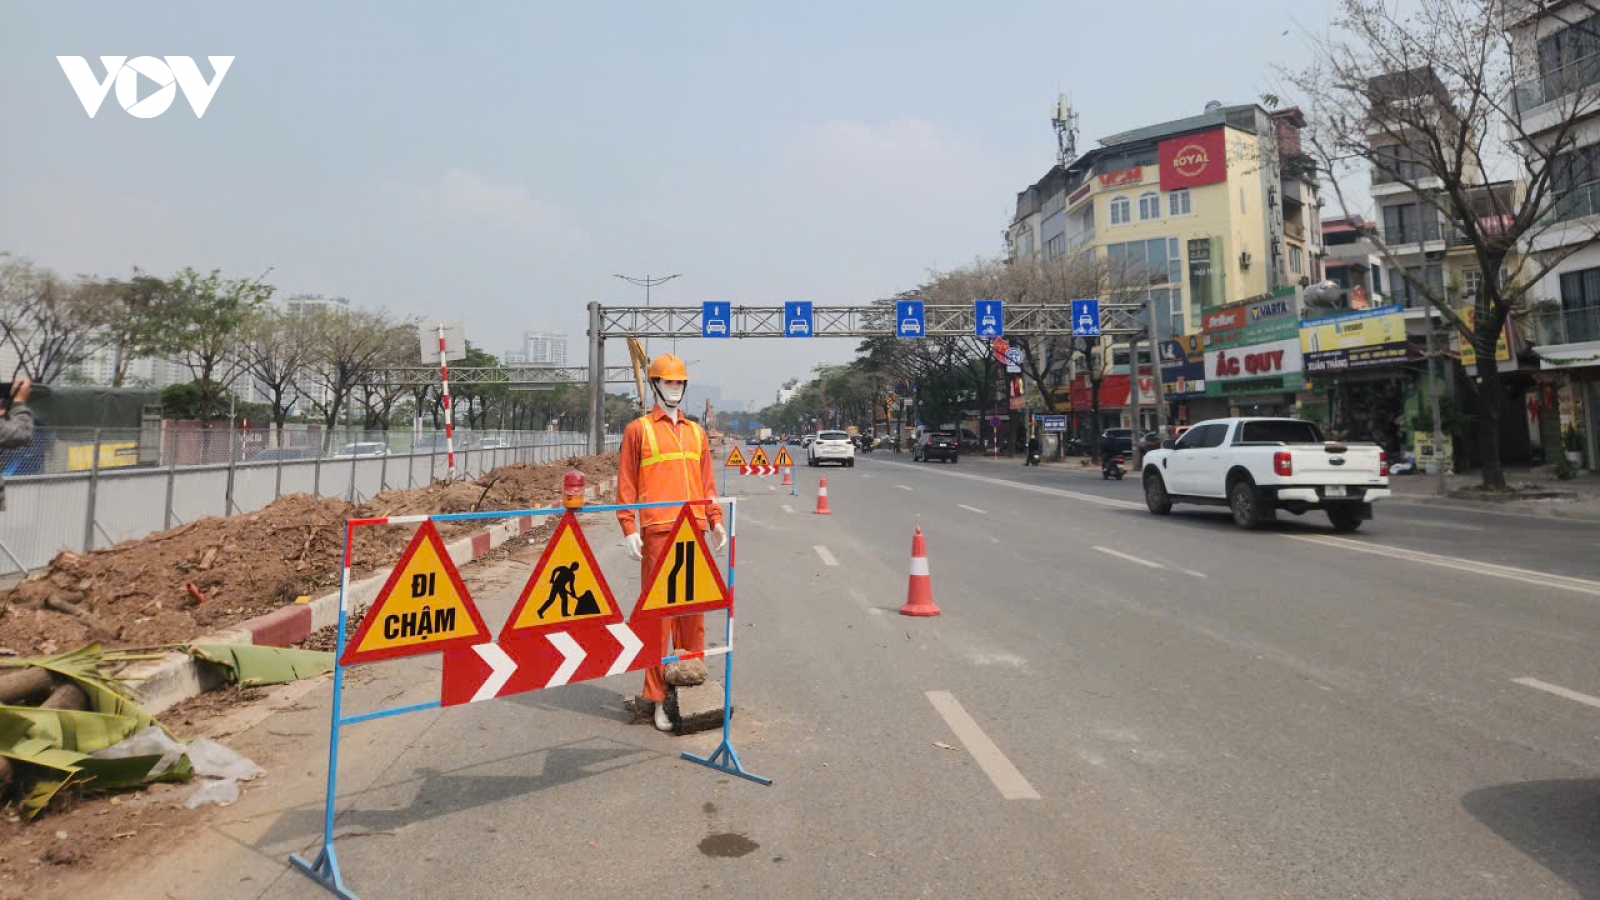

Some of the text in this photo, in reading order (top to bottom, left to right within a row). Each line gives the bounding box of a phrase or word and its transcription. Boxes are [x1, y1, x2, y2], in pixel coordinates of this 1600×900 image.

[1173, 154, 1210, 168] ROYAL
[1260, 303, 1288, 316] VARTA
[1245, 350, 1284, 375] QUY
[411, 572, 435, 598] ĐI
[384, 607, 456, 640] CHẬM
